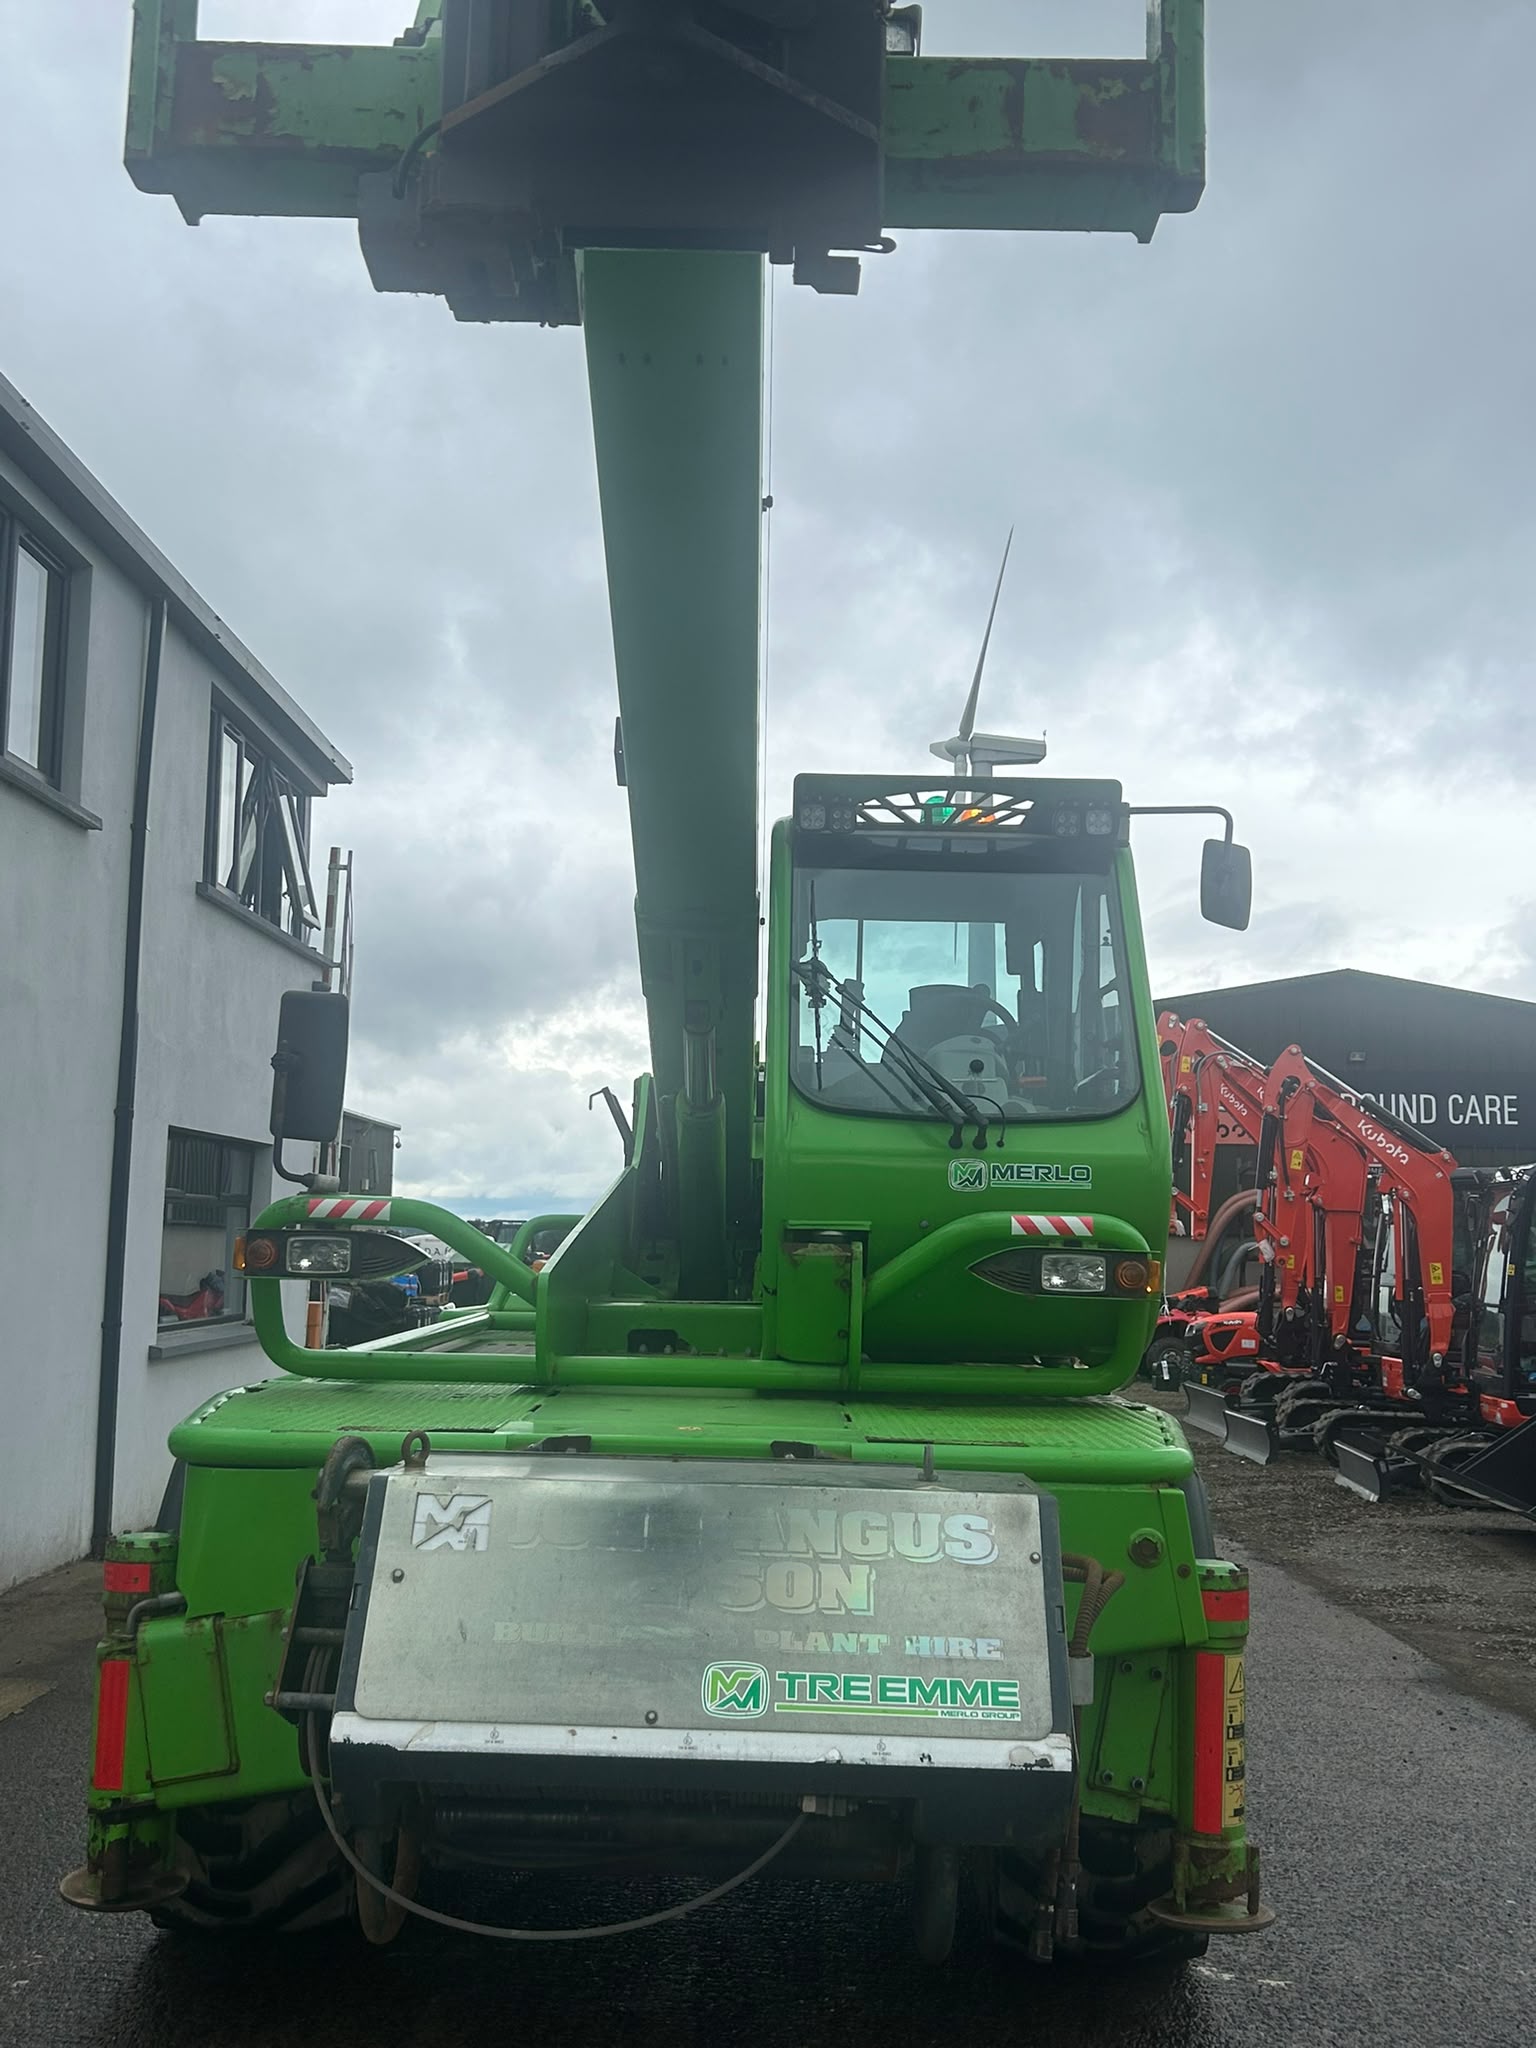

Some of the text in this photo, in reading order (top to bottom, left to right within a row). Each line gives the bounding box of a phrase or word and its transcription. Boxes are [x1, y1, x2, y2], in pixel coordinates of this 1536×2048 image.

[1220, 1083, 1248, 1116] Kubota
[1448, 1094, 1519, 1125] CARE
[1356, 1118, 1409, 1165] Kubota
[991, 1163, 1092, 1182] MERLO
[753, 1629, 889, 1656] PLANT
[904, 1634, 1005, 1661] HIRE
[776, 1671, 1021, 1709] TRE EMME
[940, 1709, 1021, 1720] MERLO GROUP
